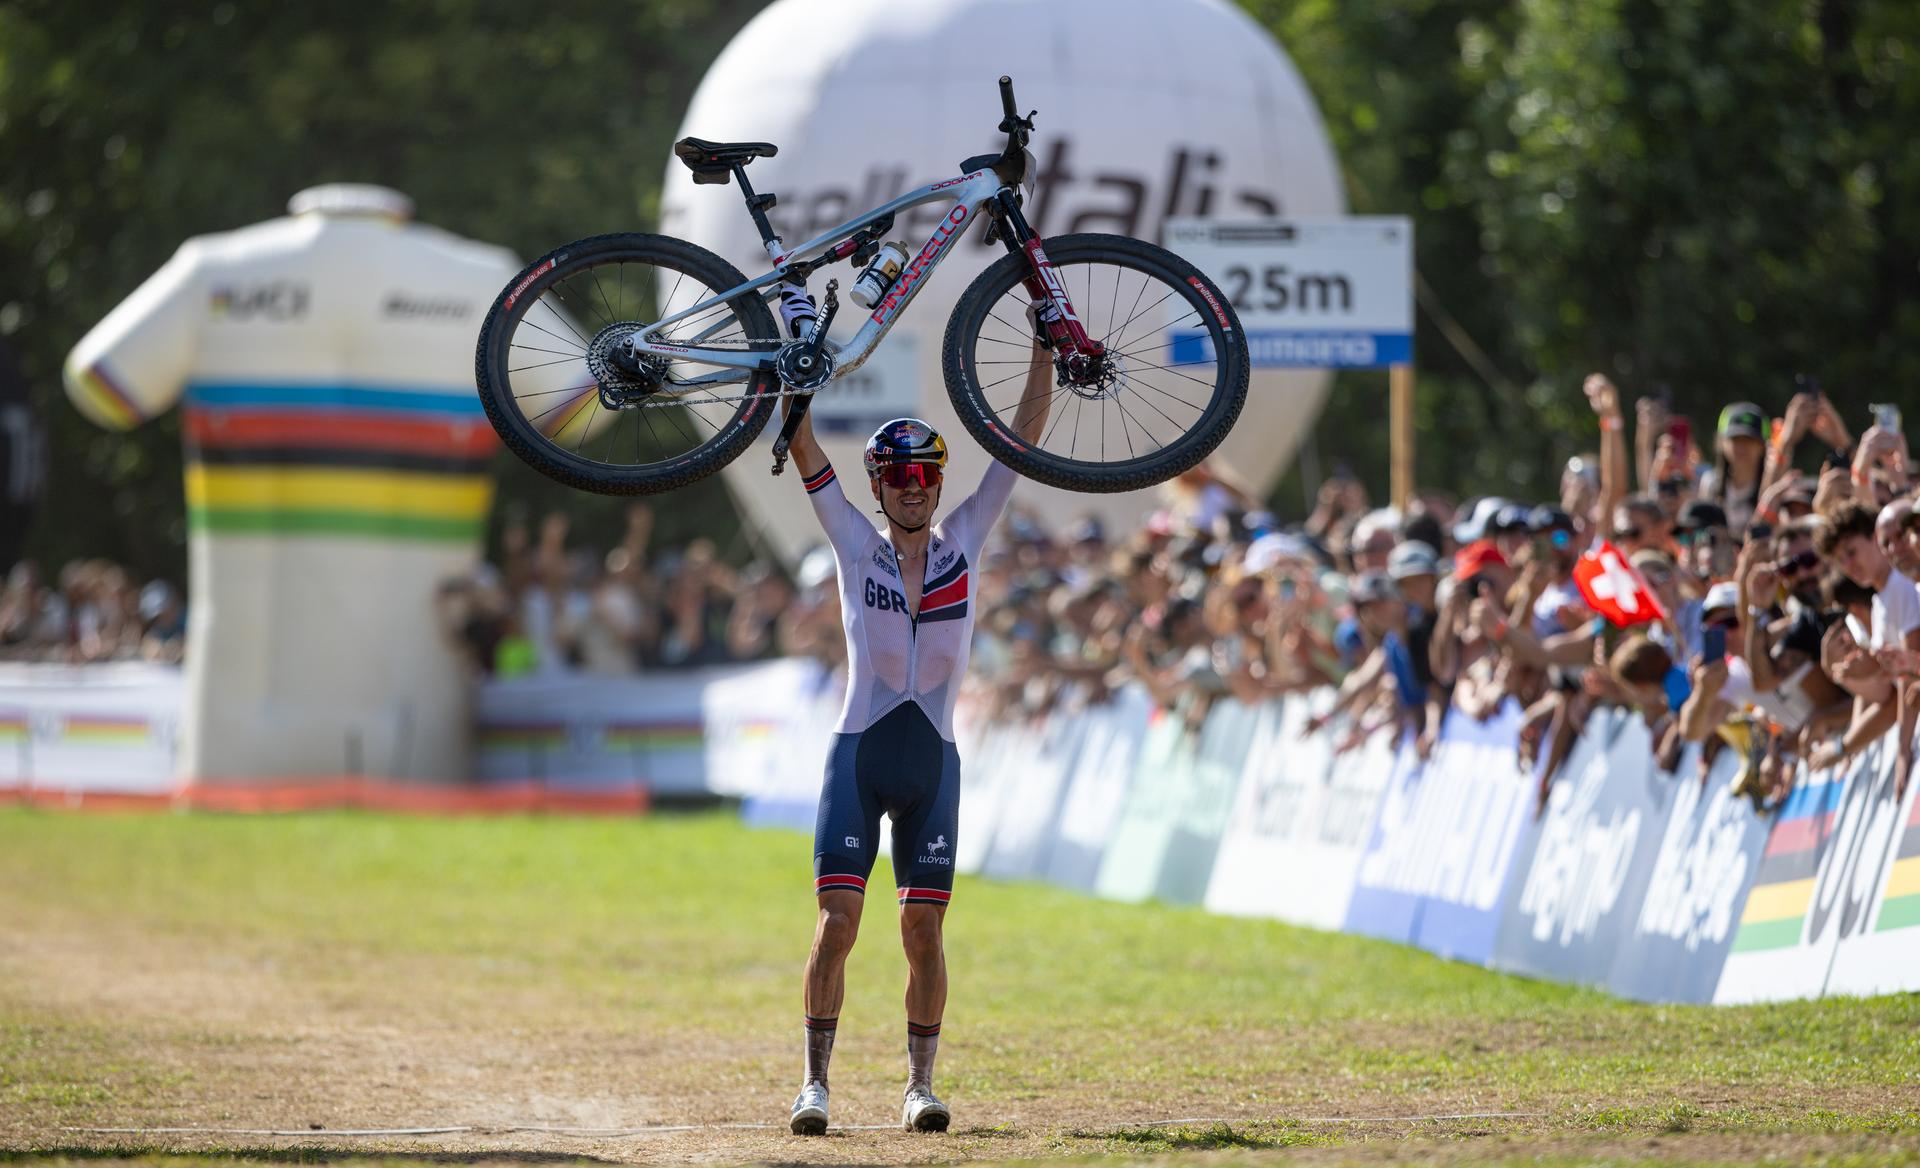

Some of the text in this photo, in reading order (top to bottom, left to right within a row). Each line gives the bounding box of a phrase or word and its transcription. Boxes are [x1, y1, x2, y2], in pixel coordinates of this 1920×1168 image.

[931, 171, 983, 191] DOGMA
[872, 204, 968, 325] PINARELLO
[1225, 264, 1353, 311] 25m
[808, 303, 829, 344] SRAM
[650, 345, 689, 353] PINARELLO
[865, 577, 909, 615] GBR
[919, 855, 950, 866] LLOYDS
